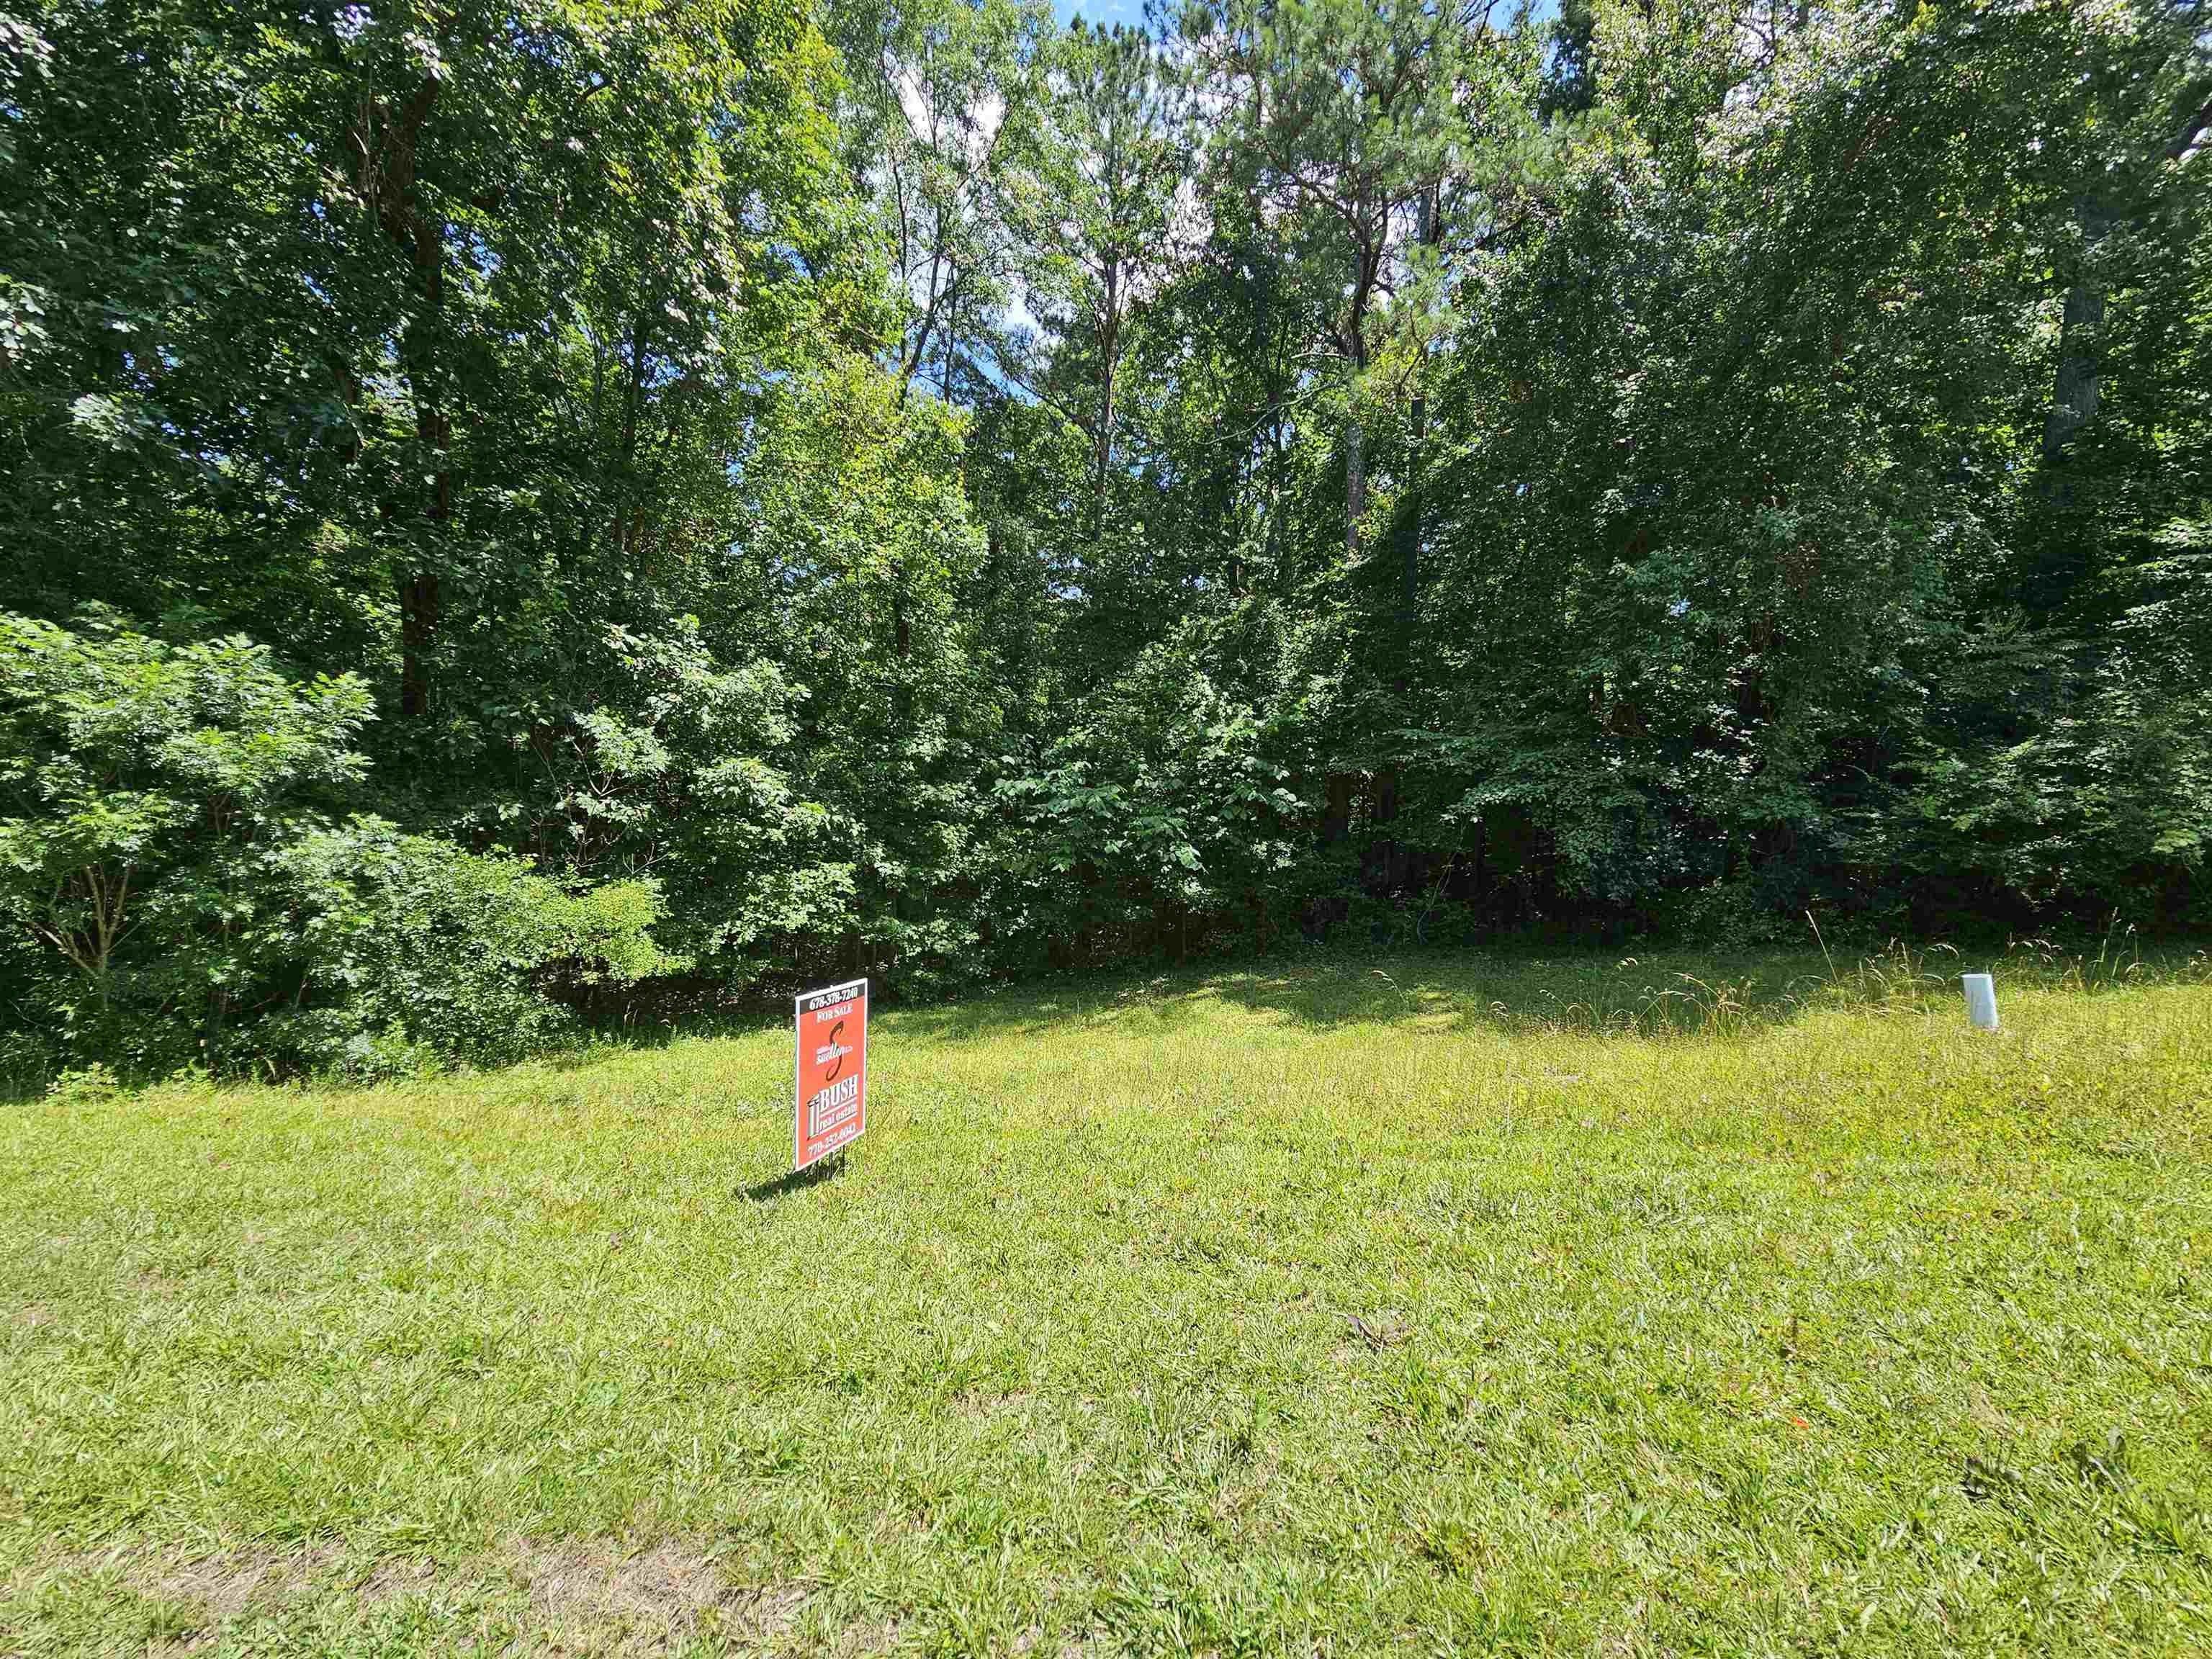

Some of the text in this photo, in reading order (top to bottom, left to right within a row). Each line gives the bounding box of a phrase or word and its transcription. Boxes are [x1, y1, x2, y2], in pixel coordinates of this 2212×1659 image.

[809, 986, 858, 1010] 678-378-7240
[817, 1002, 853, 1023] FOR SALE
[819, 1074, 858, 1112] BUSH
